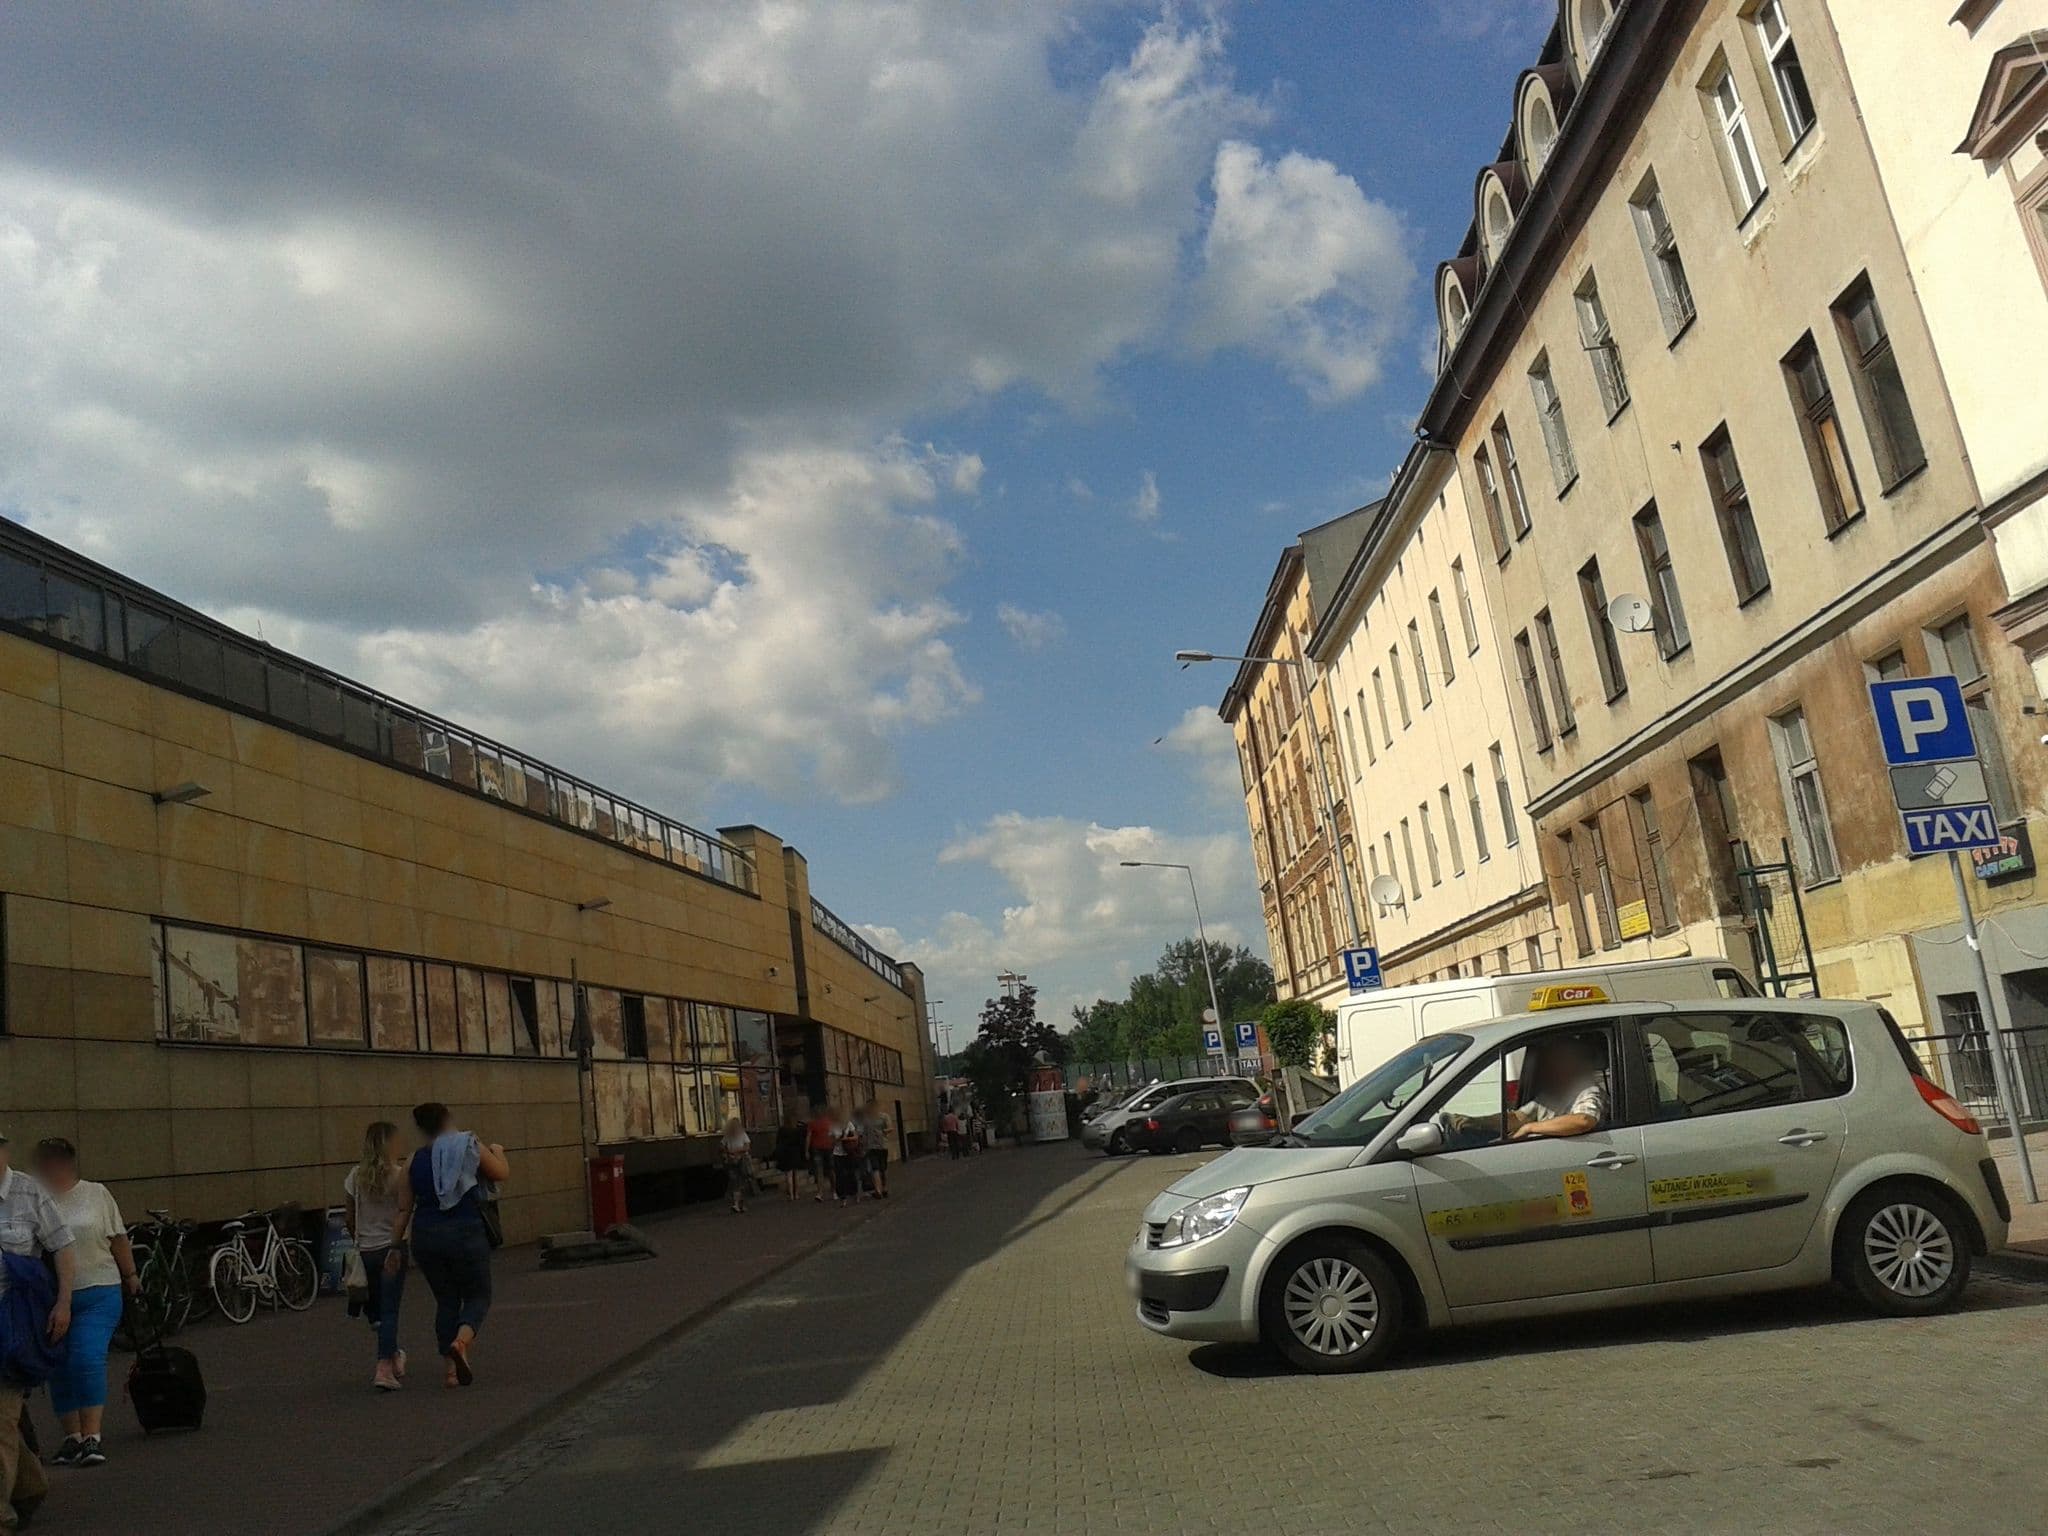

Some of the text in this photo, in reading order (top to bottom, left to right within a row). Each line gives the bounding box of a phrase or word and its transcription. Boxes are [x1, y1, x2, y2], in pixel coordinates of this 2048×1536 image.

[1890, 687, 1948, 754] P
[1907, 809, 1995, 846] TAXI
[1351, 951, 1372, 978] P
[1563, 988, 1592, 1000] Car
[1207, 1032, 1219, 1047] P
[1240, 1024, 1252, 1041] P
[1241, 1059, 1262, 1069] TAXI
